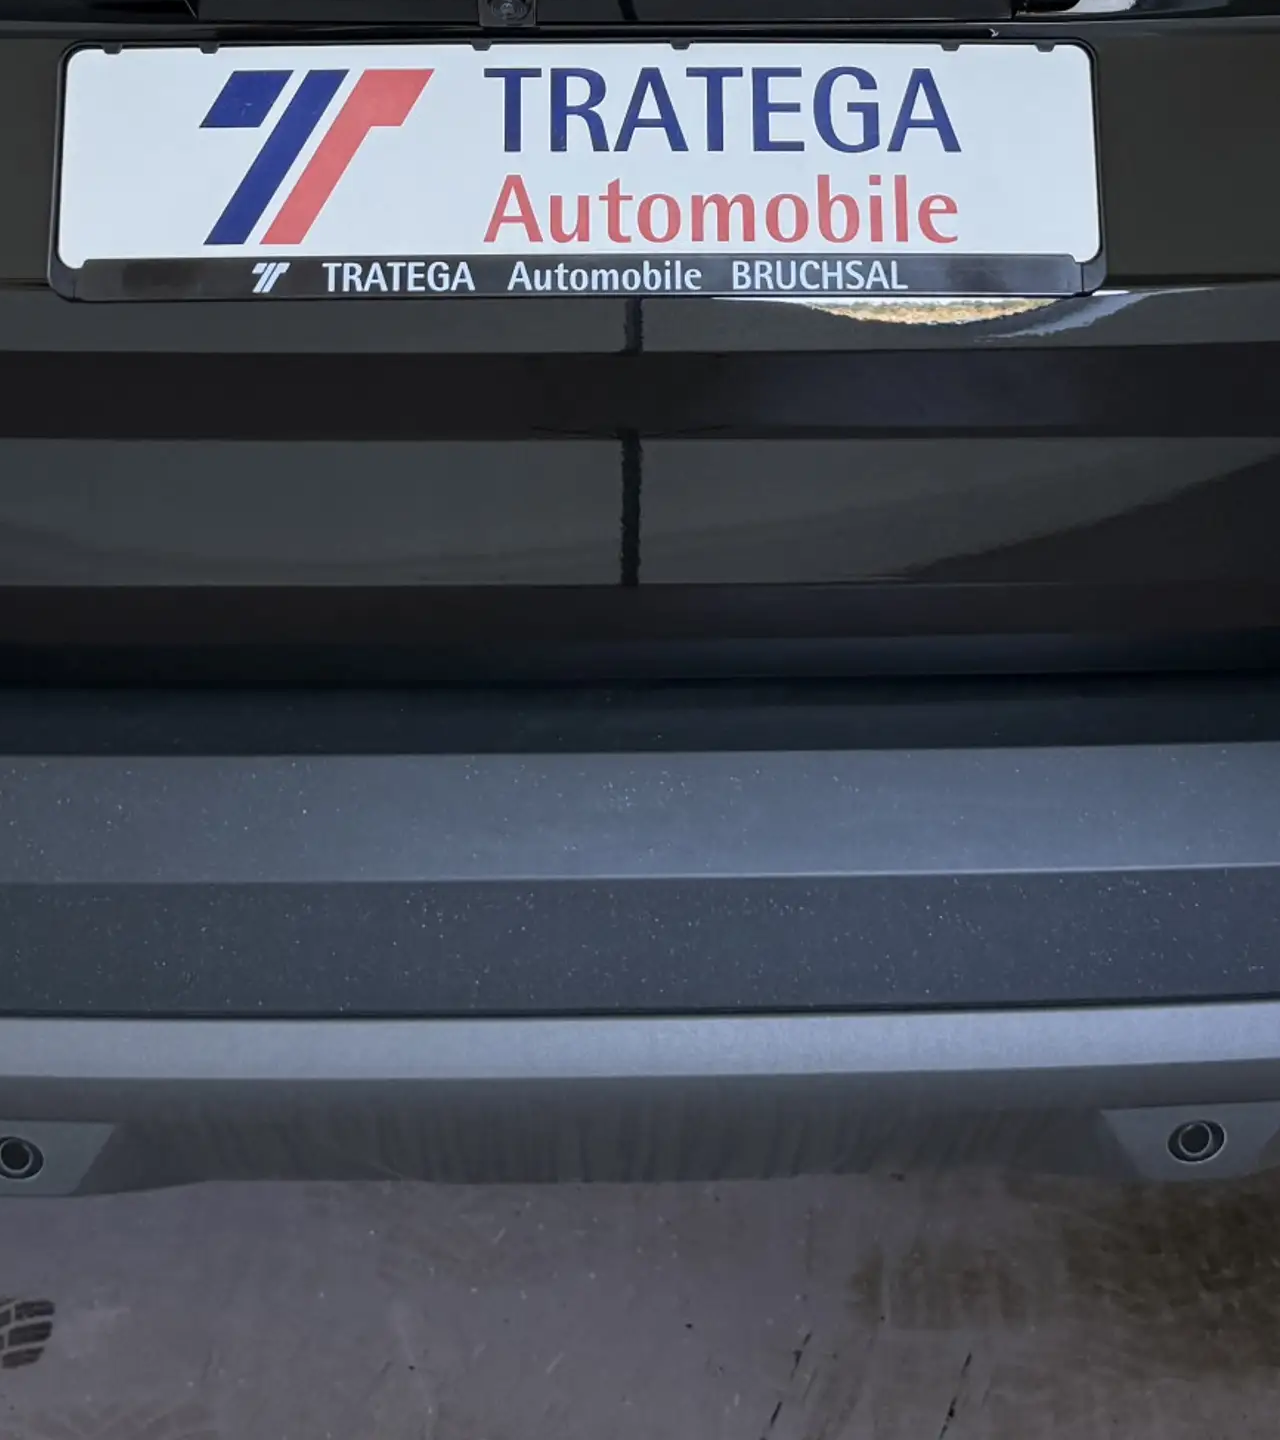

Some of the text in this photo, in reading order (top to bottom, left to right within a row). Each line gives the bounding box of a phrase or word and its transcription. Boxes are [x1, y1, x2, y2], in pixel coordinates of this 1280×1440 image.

[483, 66, 962, 154] TRATEGA
[482, 174, 960, 245] Automobile
[321, 259, 909, 293] TRATEGA Automobile BRUCHSAL
